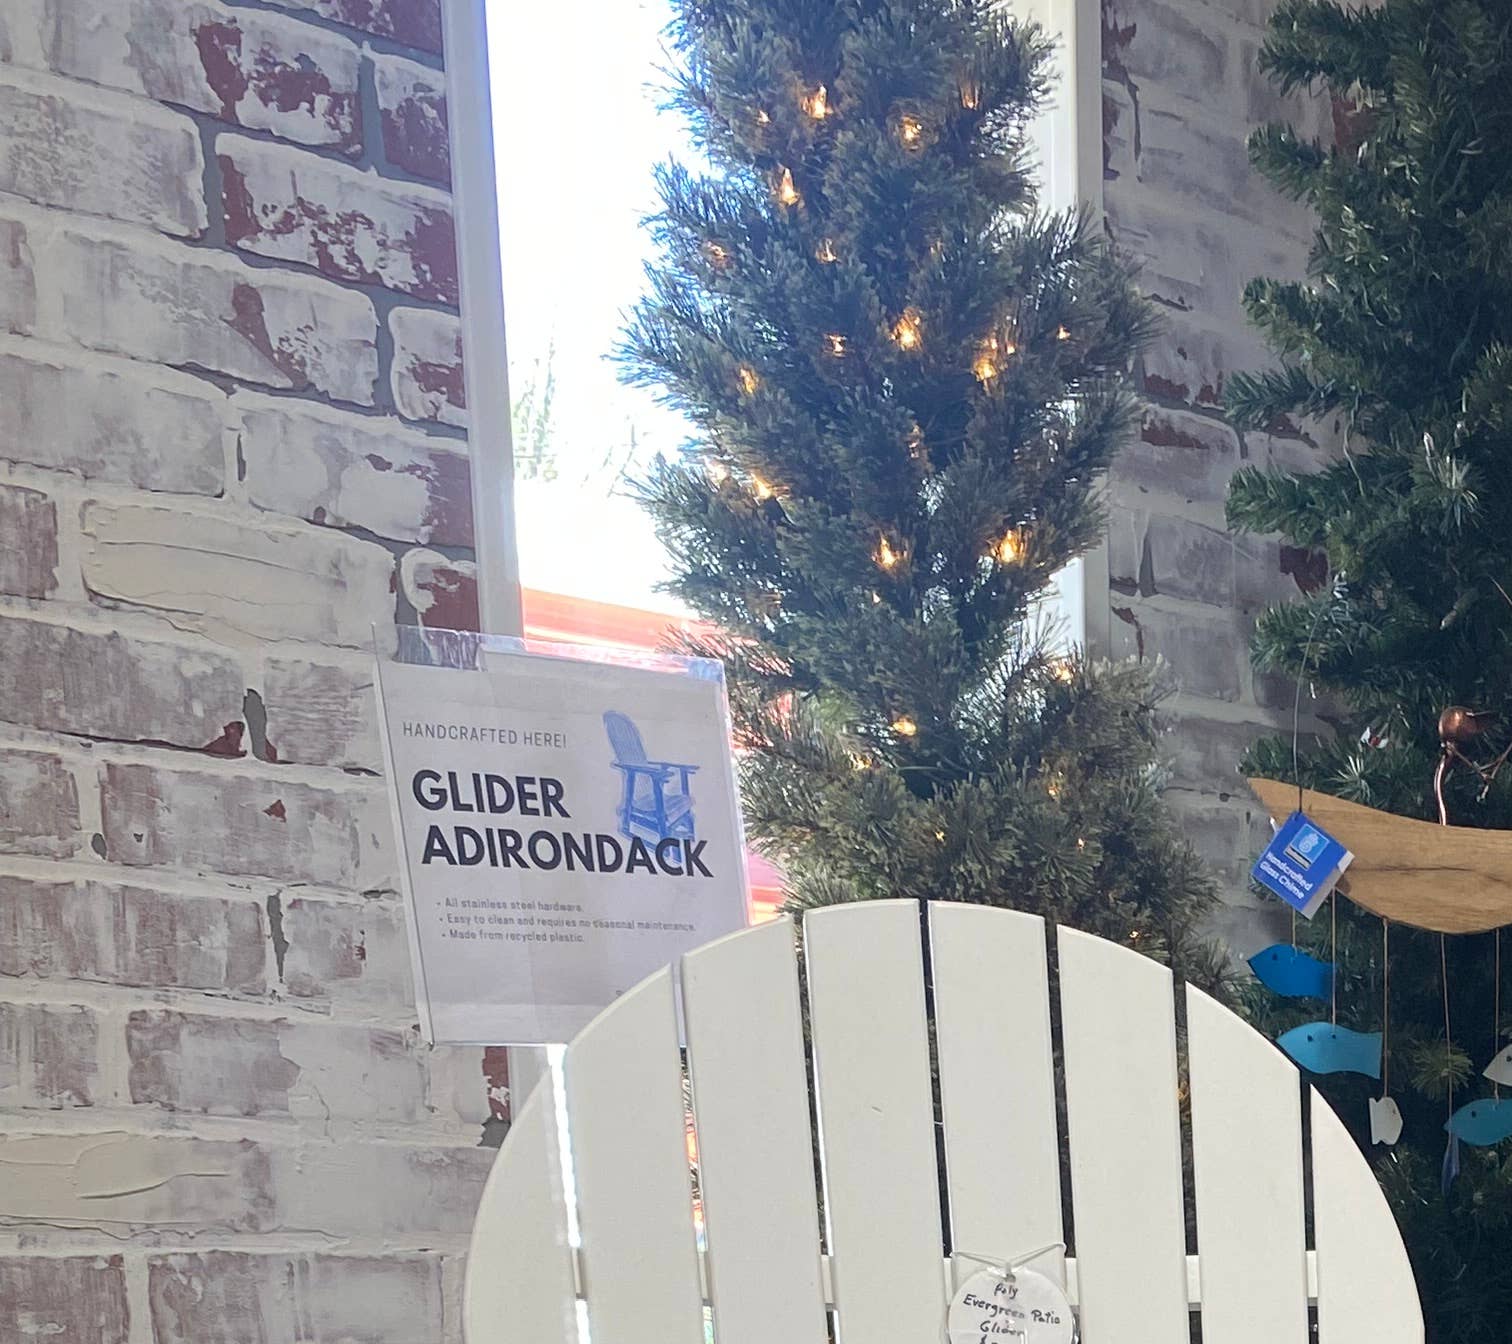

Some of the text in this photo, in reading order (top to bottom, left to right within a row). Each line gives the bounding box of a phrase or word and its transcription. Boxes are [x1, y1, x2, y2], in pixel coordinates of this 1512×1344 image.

[403, 721, 517, 744] HANDCRAFTED
[412, 769, 571, 818] GLIDER
[421, 825, 714, 878] ADIRONDACK
[1260, 861, 1305, 899] Glass Chime
[1265, 852, 1313, 891] Handcrafted
[445, 897, 458, 908] All
[461, 898, 507, 909] stainless
[510, 900, 536, 910] steel
[447, 913, 471, 926] Easy
[474, 915, 485, 925] to
[488, 914, 515, 925] clean
[517, 916, 535, 926] and
[537, 917, 576, 928] requires
[450, 929, 476, 939] Made
[480, 929, 503, 940] from
[506, 931, 547, 942] recycled
[963, 1293, 1060, 1324] Evergreen Patio
[980, 1320, 1025, 1336] Glider
